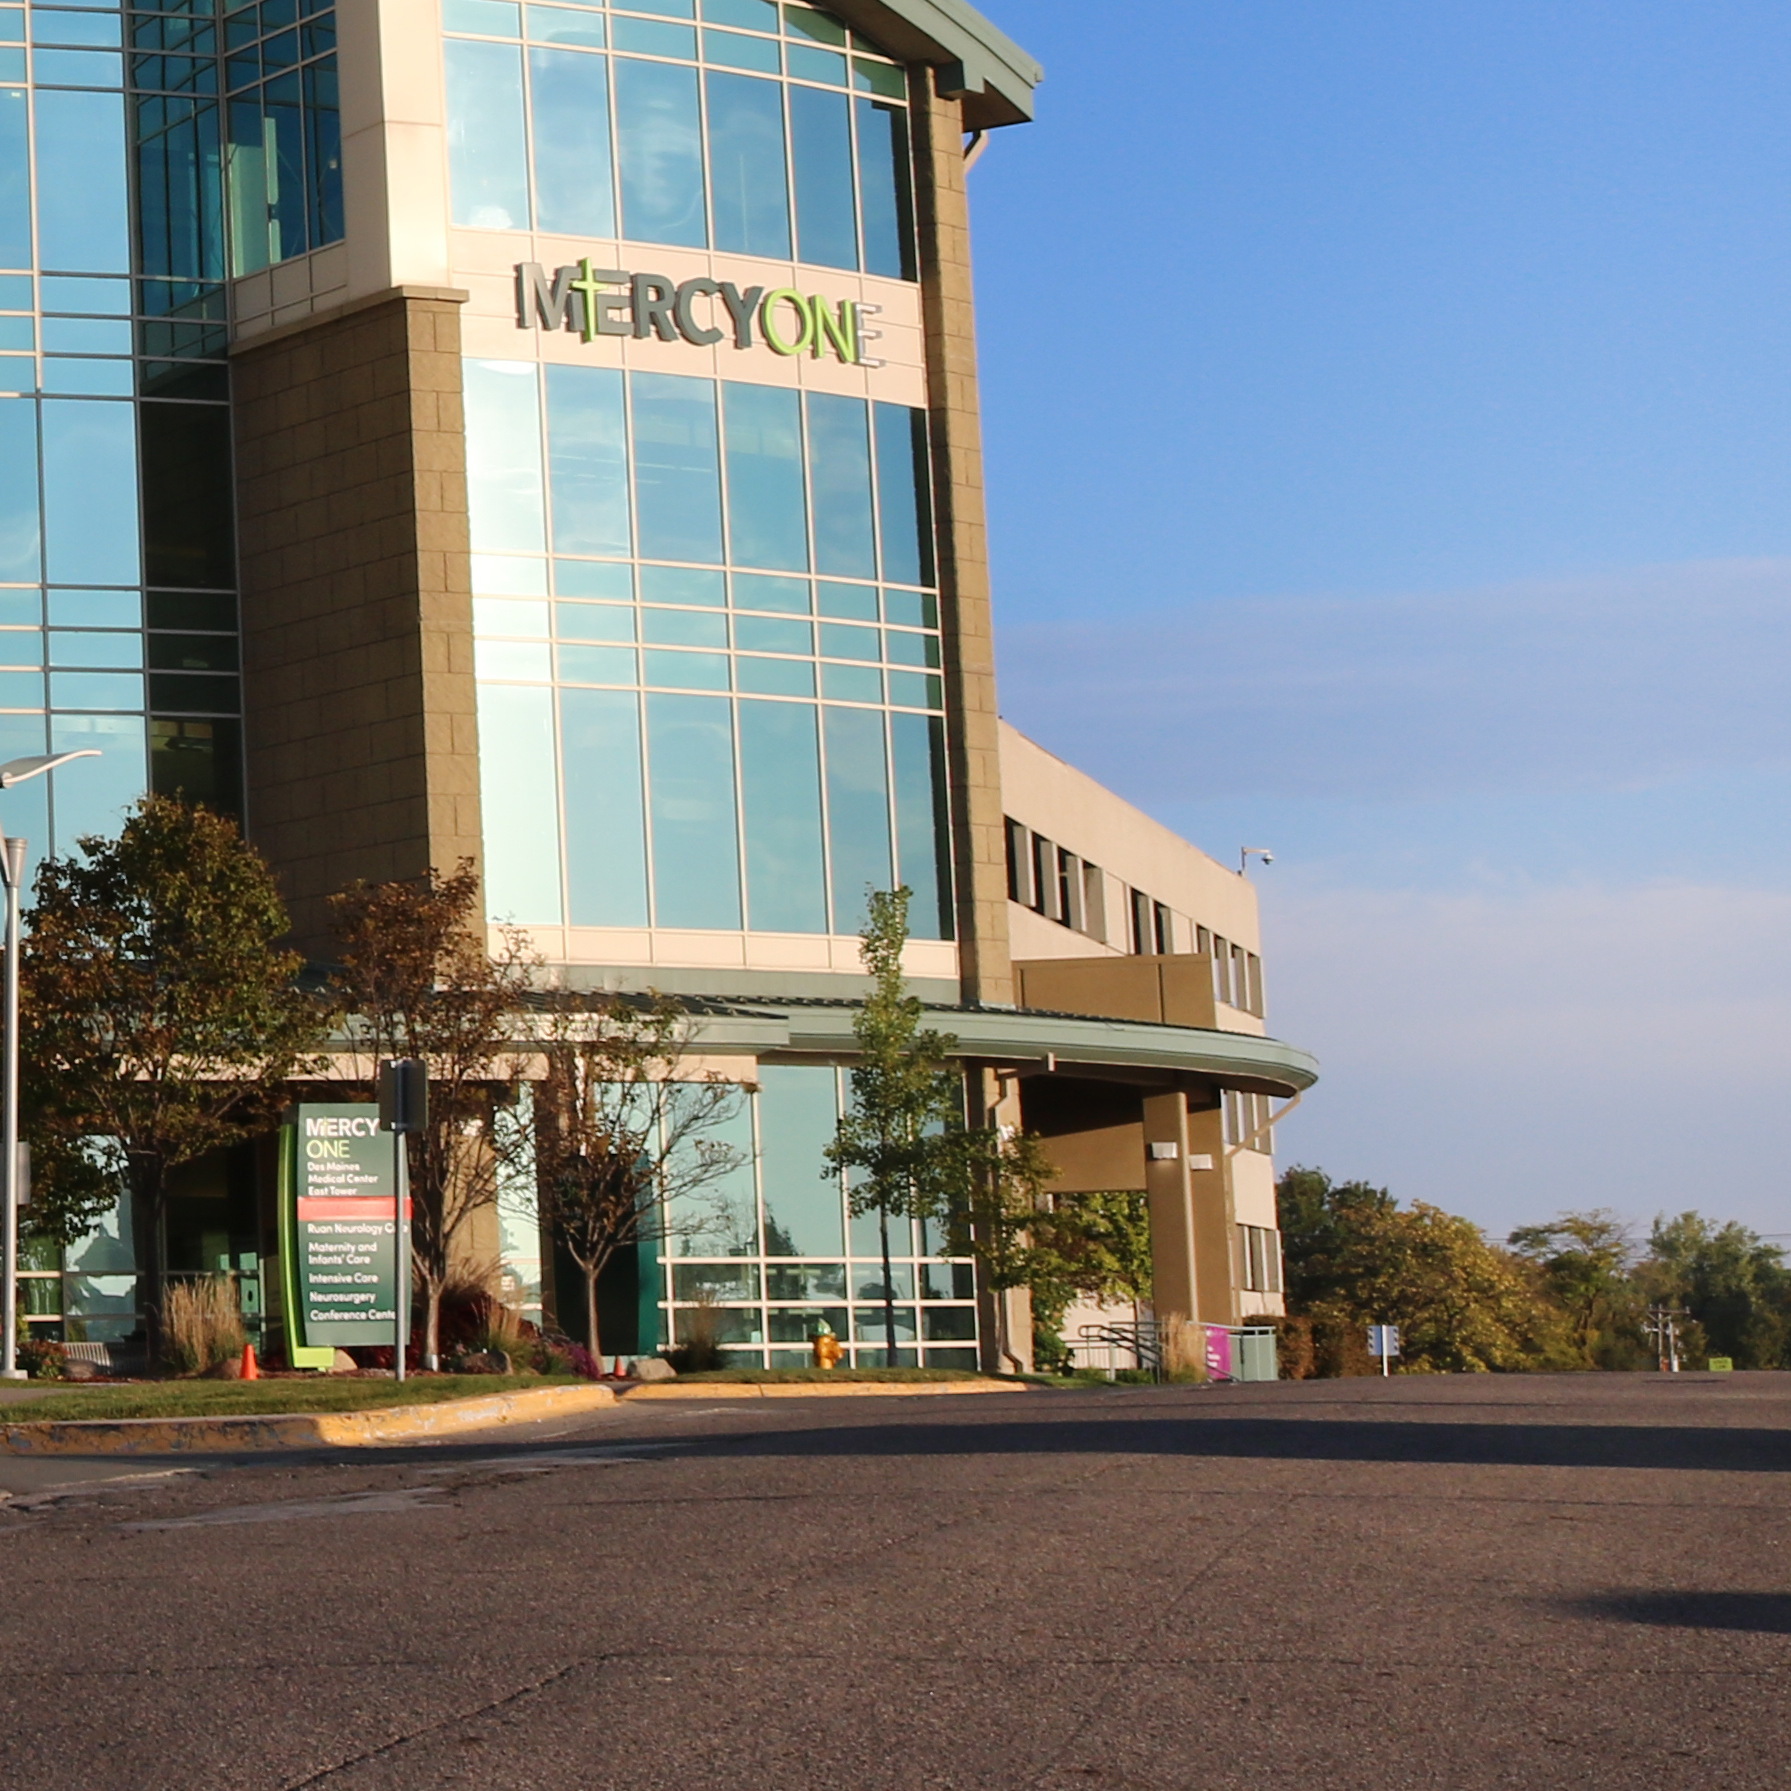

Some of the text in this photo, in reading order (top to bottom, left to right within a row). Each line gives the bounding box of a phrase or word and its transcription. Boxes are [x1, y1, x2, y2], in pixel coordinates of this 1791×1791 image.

[305, 1116, 380, 1137] MERCY
[306, 1139, 350, 1159] ONE
[307, 1161, 360, 1172] Des Moines
[308, 1174, 378, 1184] Medical Center
[308, 1186, 358, 1196] East Tower
[307, 1223, 333, 1234] Ruan
[334, 1223, 383, 1236] Neurology
[308, 1242, 377, 1254] Maternity and
[346, 1254, 371, 1265] Care
[308, 1272, 379, 1284] Intensive Care
[309, 1291, 376, 1304] Neurosurgery
[310, 1309, 396, 1321] Conference Cente
